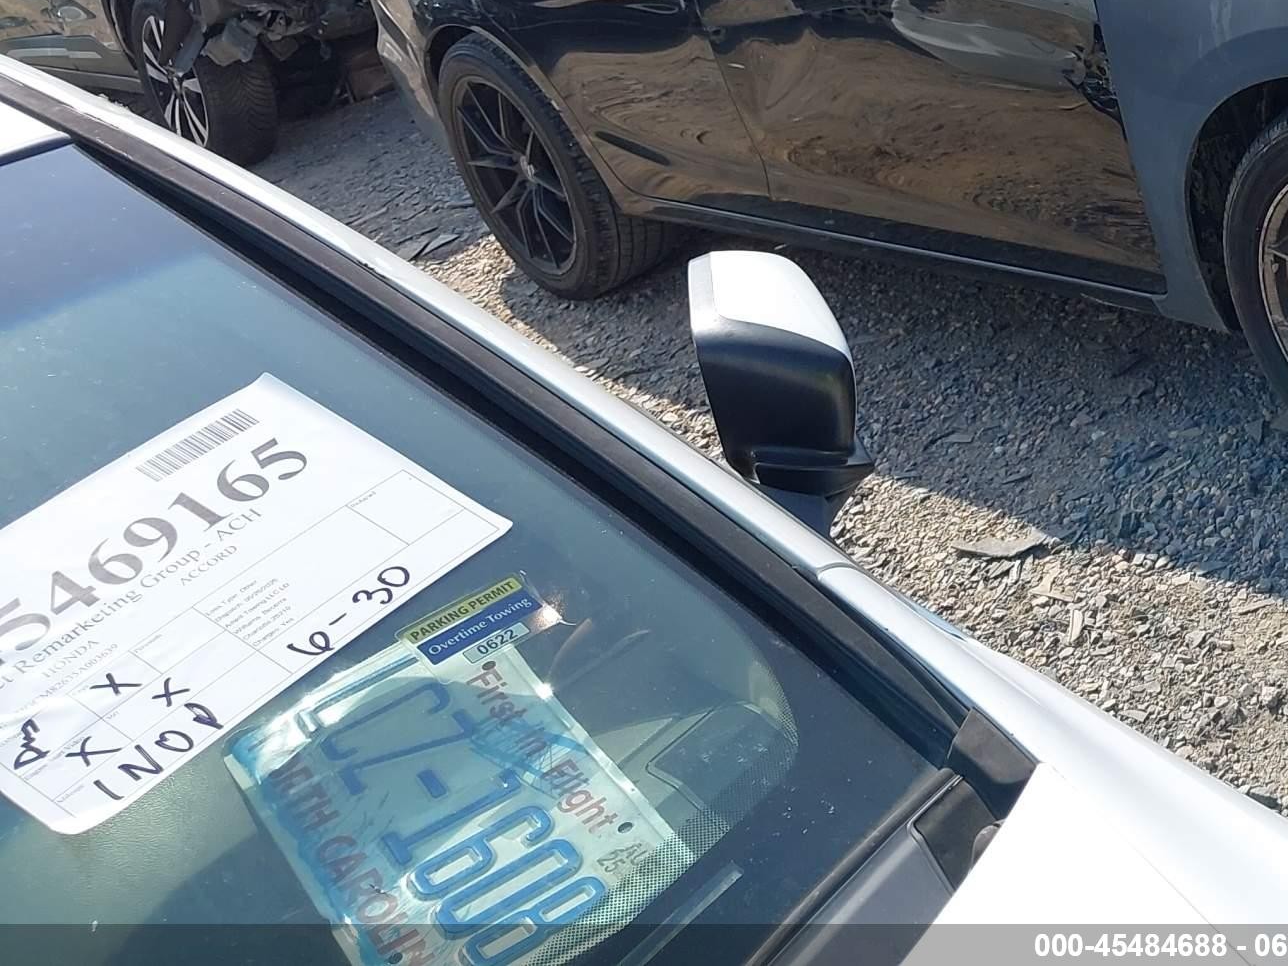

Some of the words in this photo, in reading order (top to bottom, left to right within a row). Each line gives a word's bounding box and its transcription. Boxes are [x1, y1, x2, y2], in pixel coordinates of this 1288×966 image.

[0, 437, 308, 666] 5469165
[180, 545, 238, 586] ACCORD
[15, 589, 143, 675] Remarketing
[140, 547, 202, 589] Group
[216, 508, 262, 542] ACH
[410, 606, 469, 641] PARKING
[470, 581, 516, 610] PERMIT
[428, 619, 488, 655] Overtime
[485, 598, 532, 623] Towing
[476, 629, 518, 655] 0622
[43, 639, 100, 678] HONDA
[467, 666, 528, 727] First
[541, 758, 619, 834] Flight
